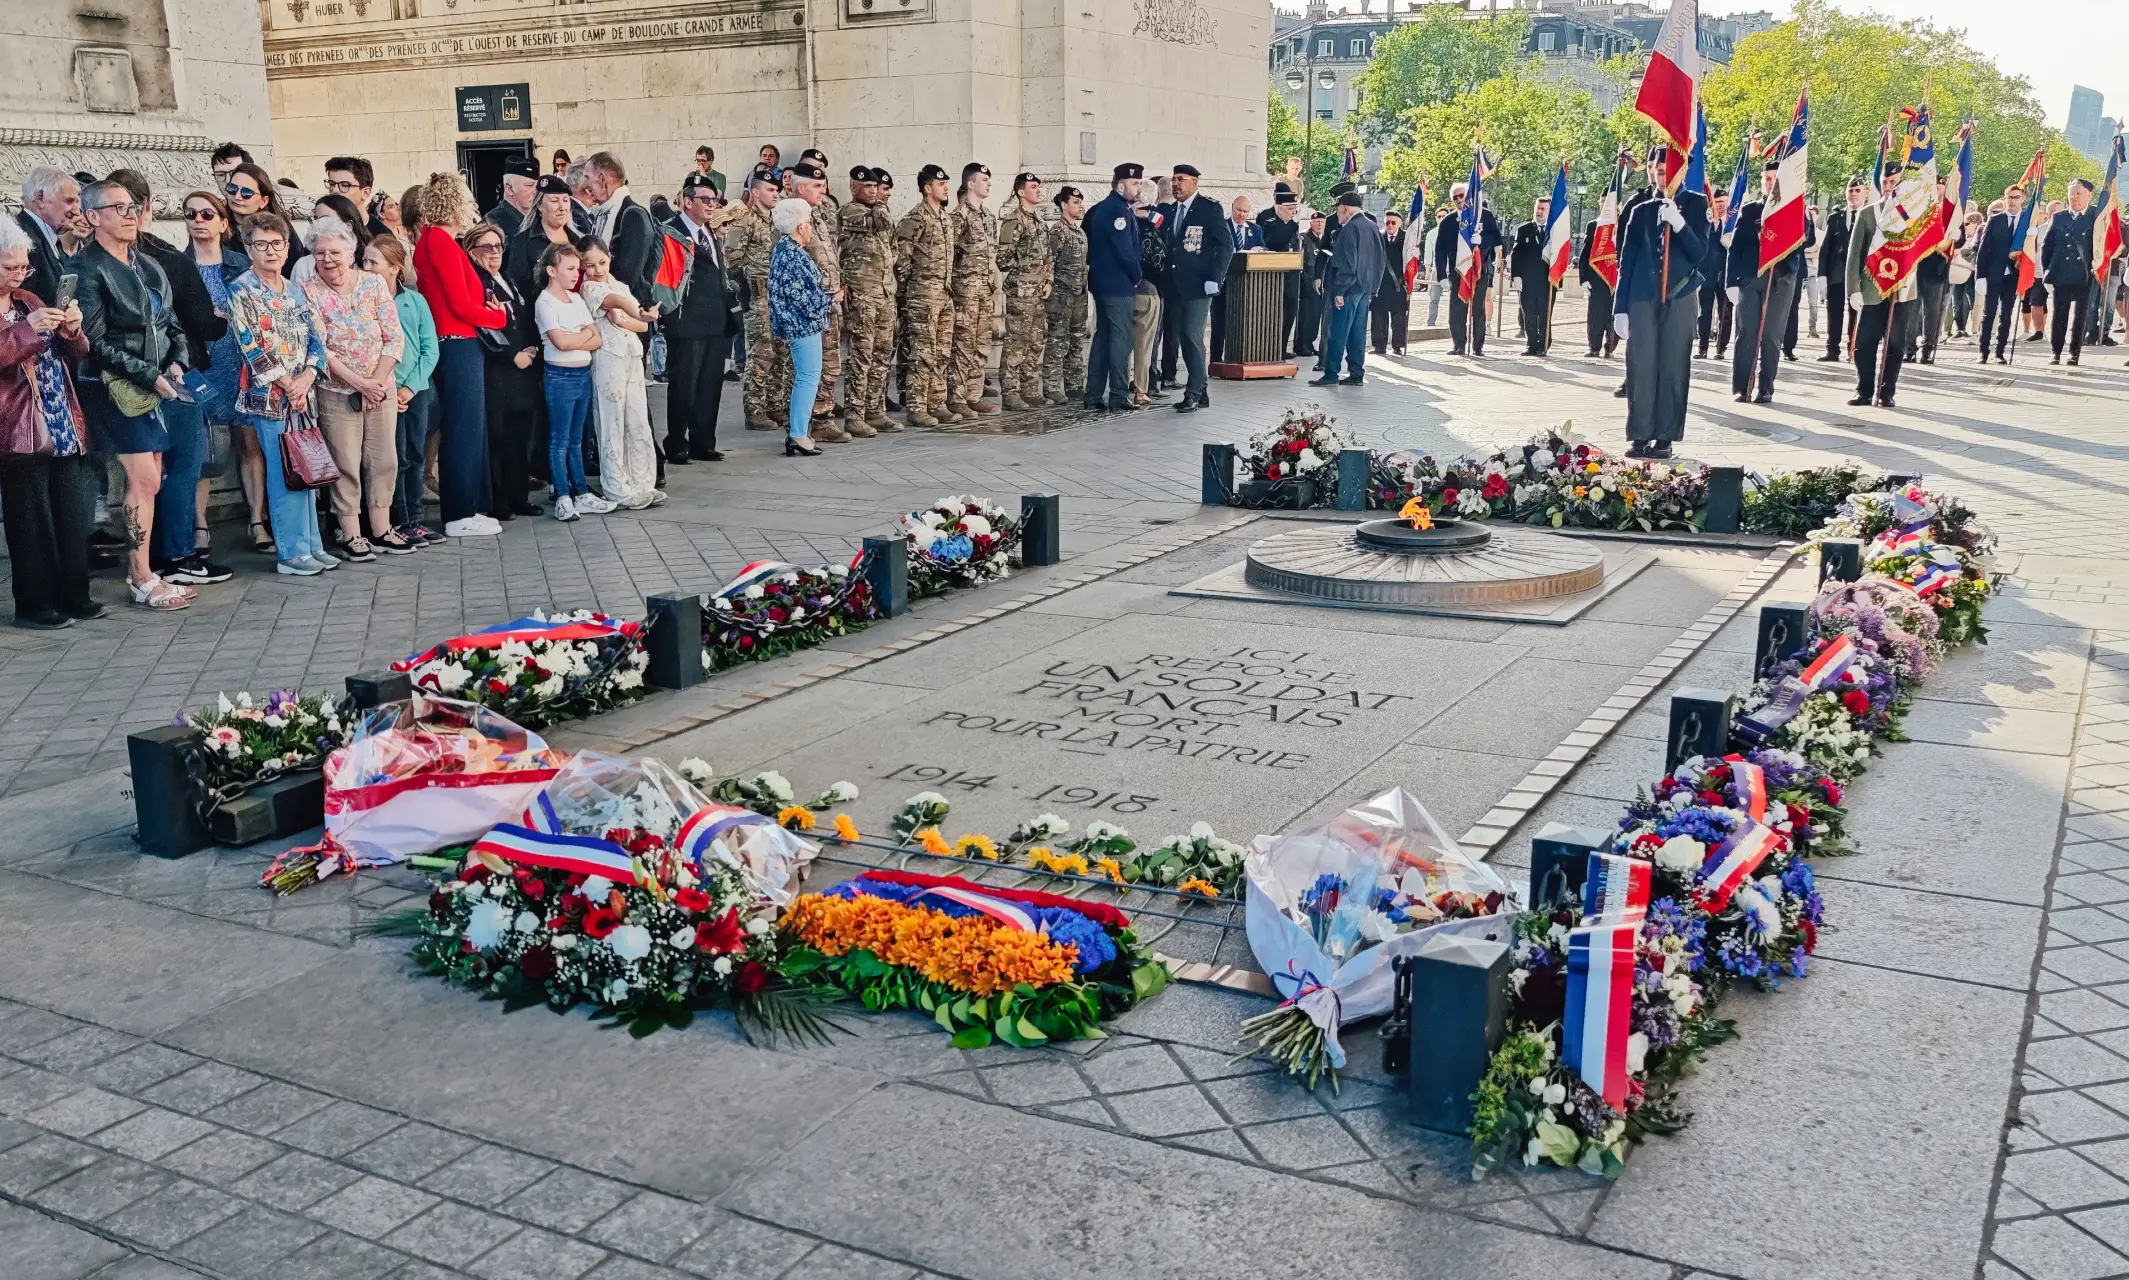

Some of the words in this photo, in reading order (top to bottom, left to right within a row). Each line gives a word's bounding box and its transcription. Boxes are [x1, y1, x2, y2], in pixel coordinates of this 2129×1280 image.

[315, 3, 344, 16] HUBER
[265, 53, 286, 66] MEES
[289, 51, 303, 64] DES
[369, 46, 383, 59] DES
[453, 39, 464, 52] DE
[469, 37, 502, 51] L'OUEST
[506, 35, 518, 48] DE
[563, 31, 576, 43] DU
[581, 28, 606, 42] CAMP
[612, 26, 624, 39] DE
[629, 22, 679, 39] BOULOGNE
[685, 18, 724, 34] GRANDE
[1131, 654, 1356, 684] REPOSE
[1224, 647, 1309, 663] ICI
[1044, 661, 1145, 682] UN
[1139, 673, 1413, 709] SOLDAT
[920, 711, 1061, 738] POUR
[1056, 727, 1120, 747] LA
[1124, 735, 1310, 769] PATRIE
[1056, 707, 1240, 735] MORT
[878, 764, 998, 791] 1914
[1031, 784, 1160, 813] 1918
